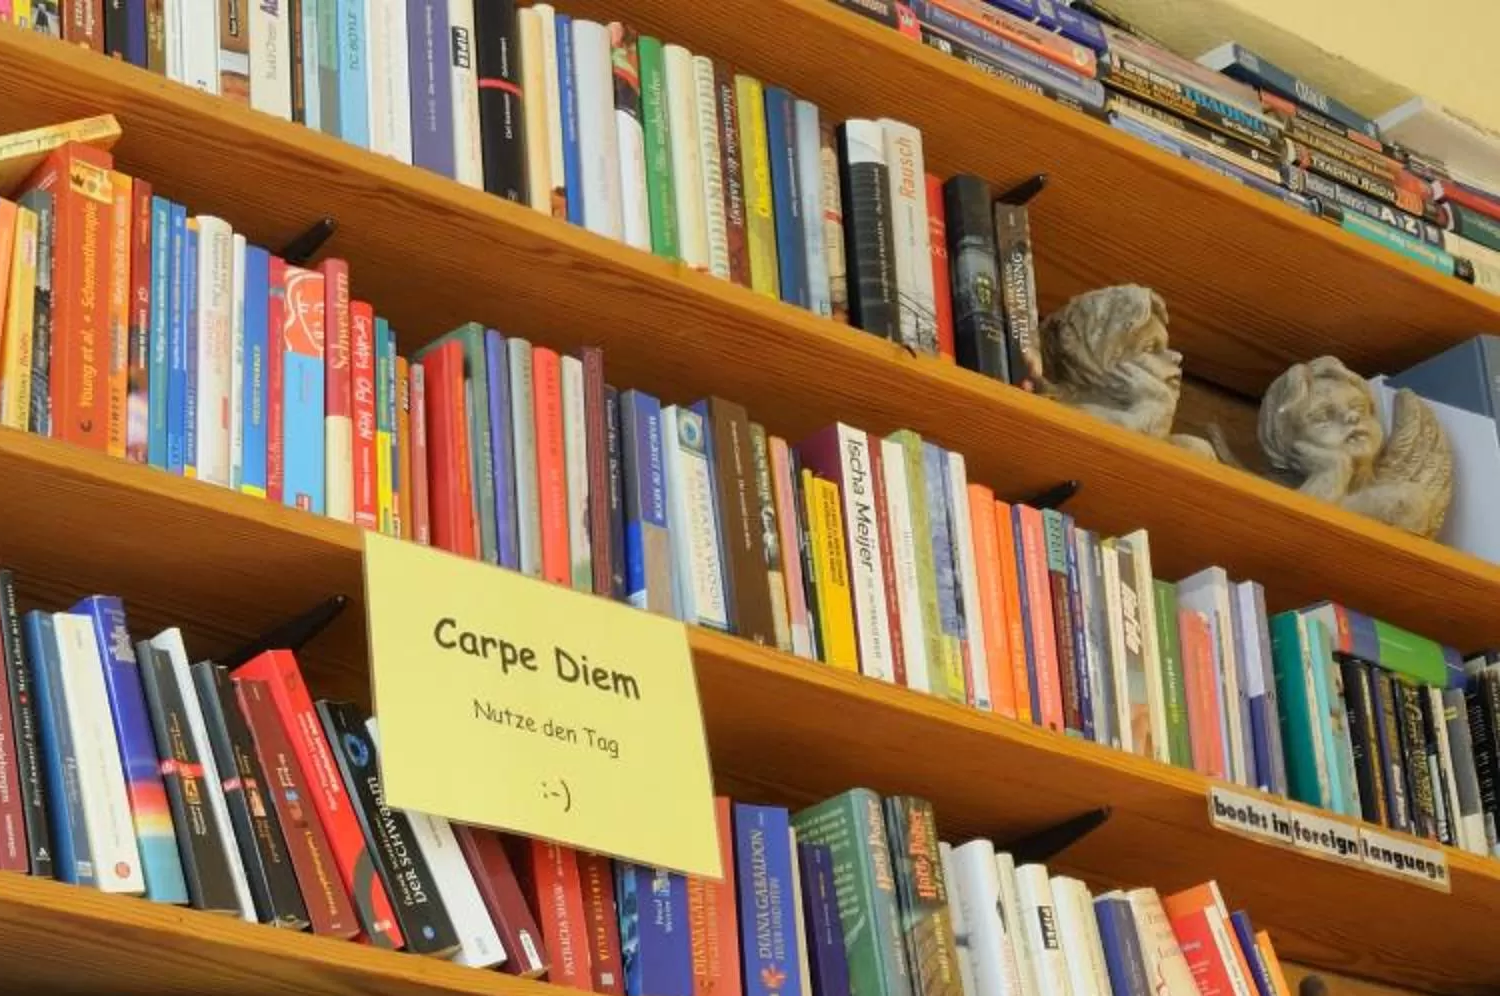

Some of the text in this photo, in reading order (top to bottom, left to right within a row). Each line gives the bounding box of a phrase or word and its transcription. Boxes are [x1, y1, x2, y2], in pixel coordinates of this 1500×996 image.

[896, 136, 916, 199] Rausch
[328, 270, 352, 369] Schwestern
[847, 438, 877, 574] Ischa Meijer
[434, 617, 640, 700] Carpe Diem
[473, 700, 620, 758] Nutze den Tag
[904, 807, 936, 898] Harry Potter
[1208, 795, 1271, 830] books
[1268, 812, 1292, 835] in
[1289, 819, 1359, 858] foreign
[746, 829, 773, 959] DIANA GABALDON
[689, 928, 709, 975] DIANA
